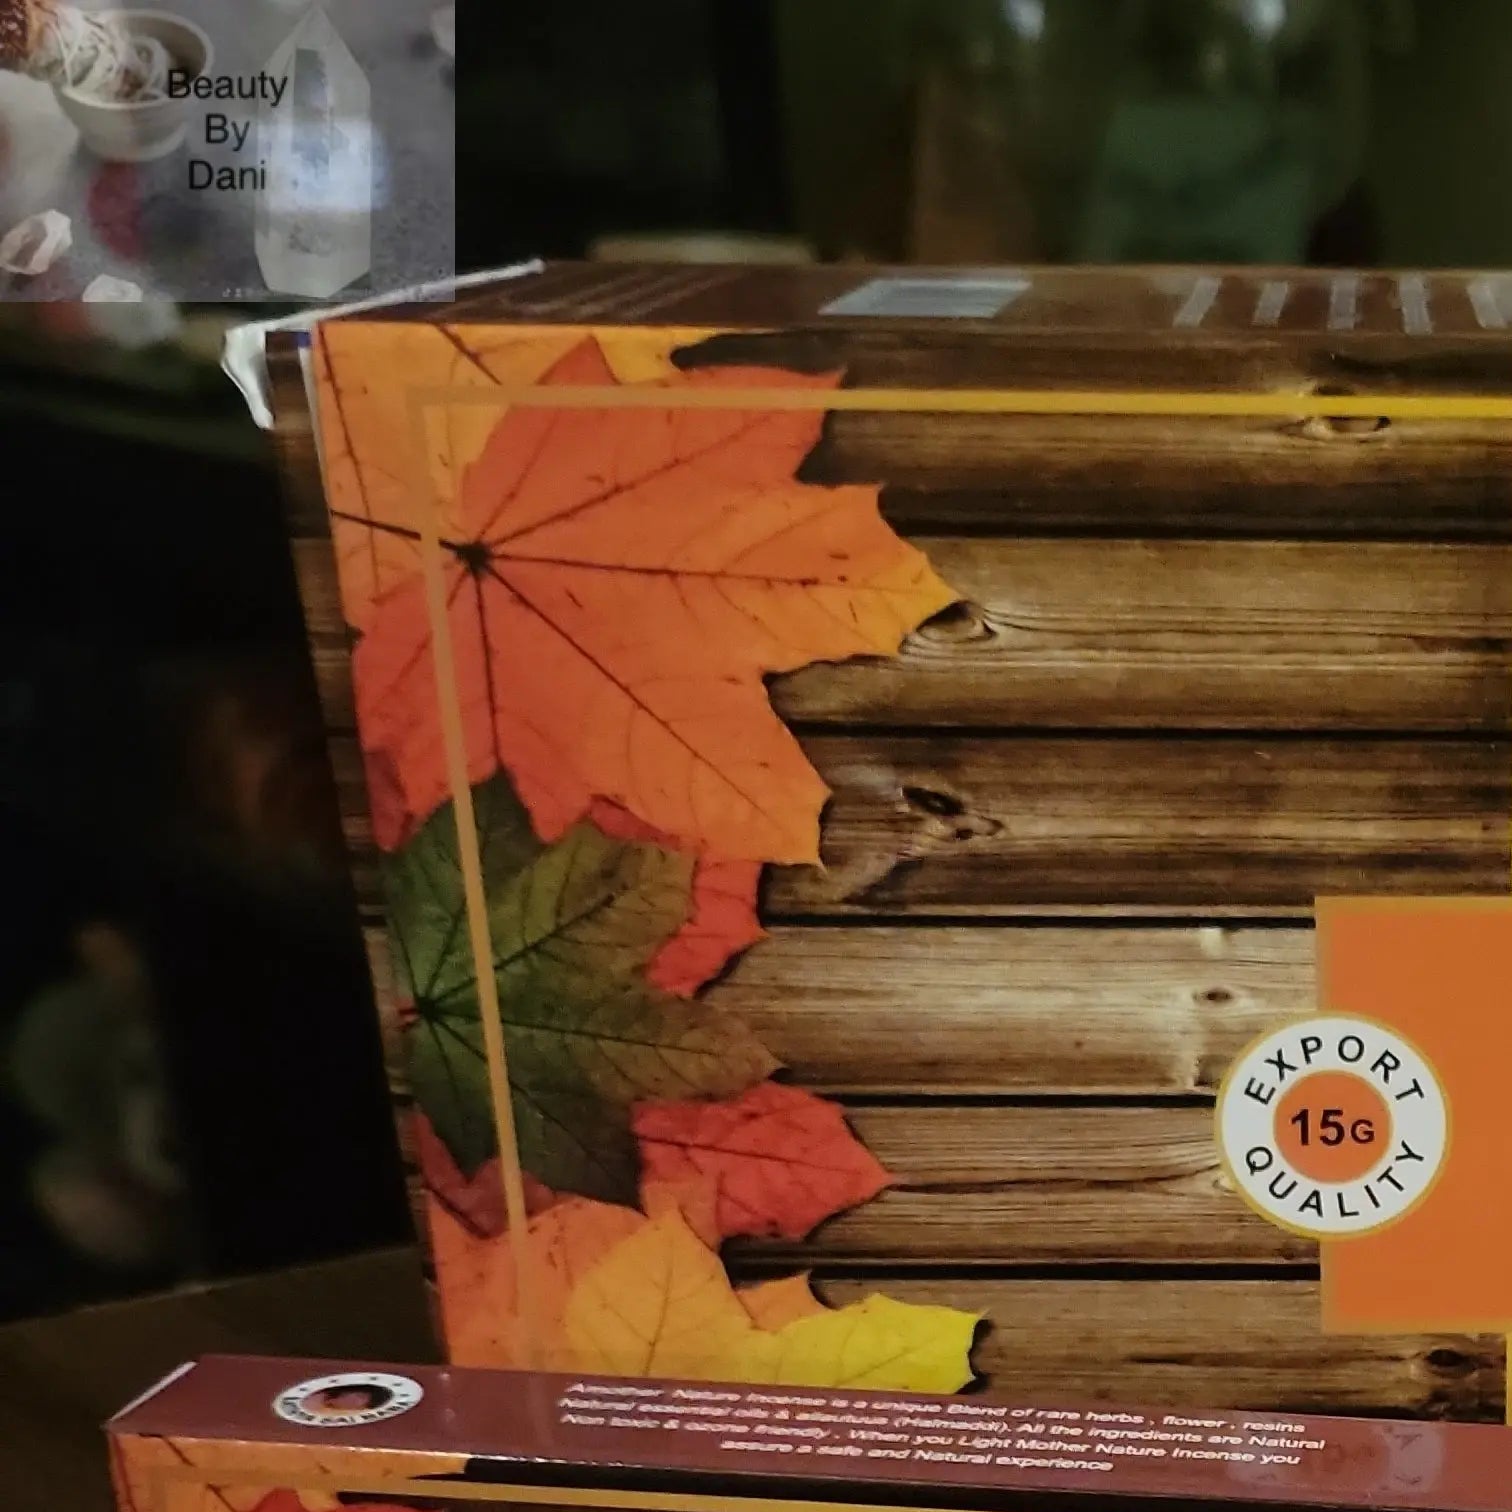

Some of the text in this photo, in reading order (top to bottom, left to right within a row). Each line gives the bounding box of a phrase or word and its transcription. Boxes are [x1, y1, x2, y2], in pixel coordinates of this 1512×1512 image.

[1244, 1035, 1425, 1105] EXPORT
[1291, 1108, 1375, 1147] 15G
[1245, 1140, 1425, 1217] QUALITY
[946, 1403, 1007, 1417] Blend
[1011, 1407, 1034, 1419] of
[1037, 1409, 1080, 1421] rare
[1085, 1410, 1144, 1425] herbs
[1162, 1414, 1225, 1429] flower
[1243, 1420, 1305, 1433] resins
[1016, 1422, 1044, 1436] All
[1049, 1423, 1083, 1437] the
[1088, 1425, 1204, 1444] ingredients
[1208, 1434, 1242, 1446] are
[1249, 1434, 1326, 1451] Natural
[850, 1427, 910, 1443] When
[911, 1434, 954, 1447] you
[958, 1434, 1011, 1449] Light
[1015, 1437, 1091, 1453] Mother
[1096, 1441, 1167, 1457] Nature
[1172, 1446, 1255, 1462] Incense
[1259, 1452, 1302, 1467] you
[867, 1447, 911, 1460] and
[913, 1449, 993, 1465] Natural
[996, 1455, 1114, 1473] experience
